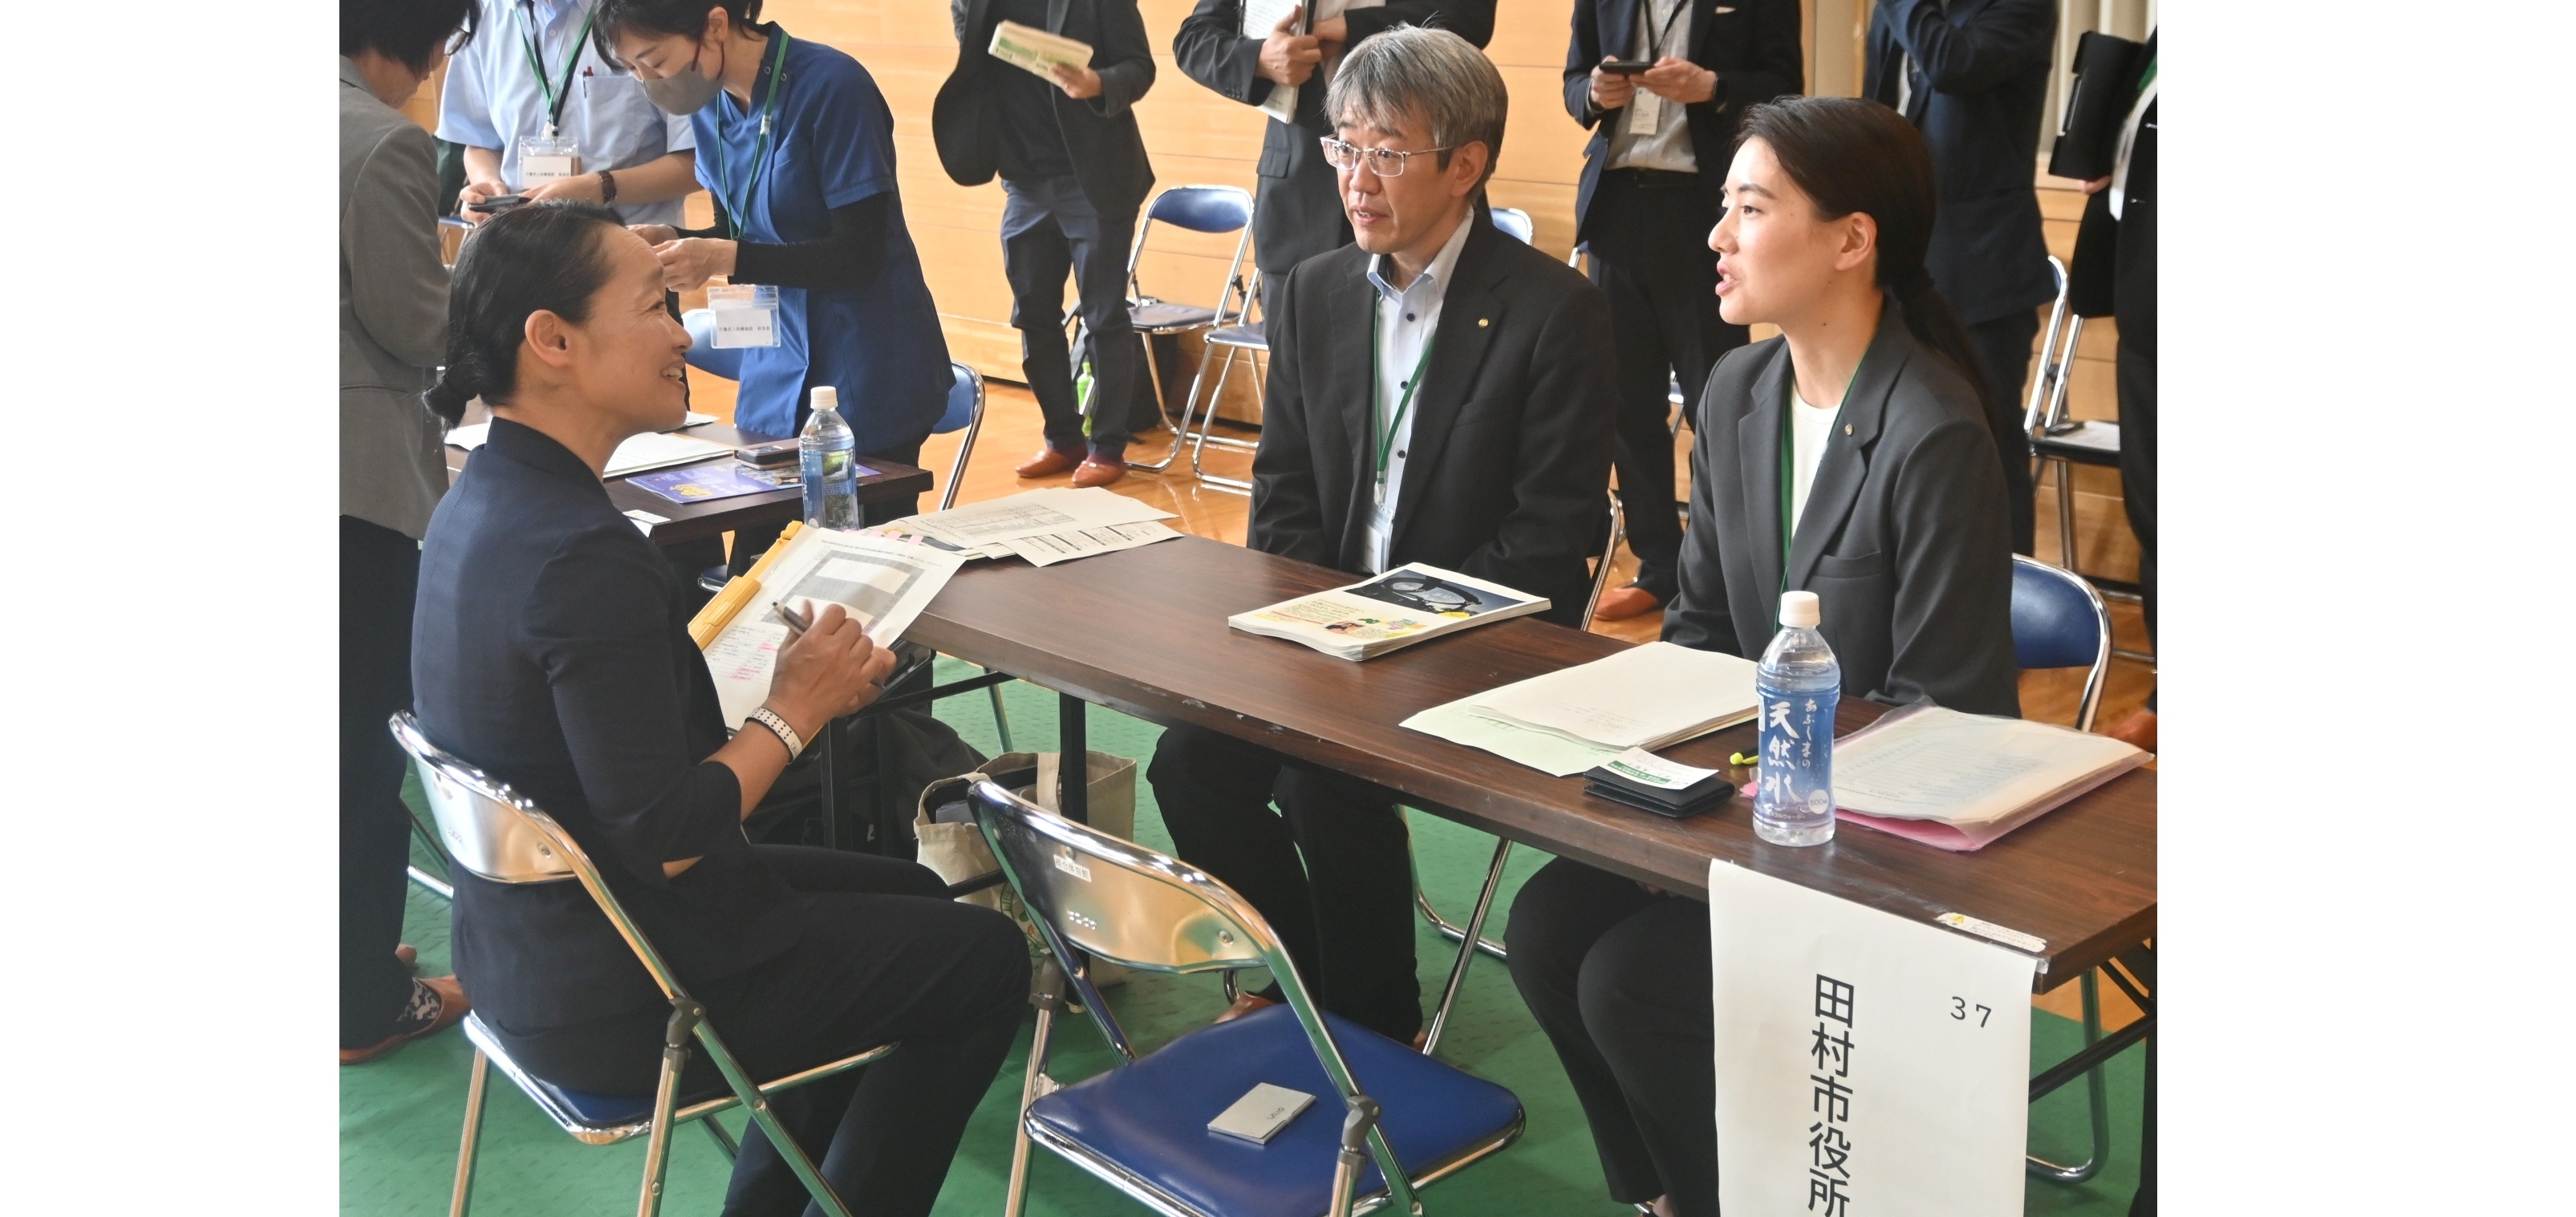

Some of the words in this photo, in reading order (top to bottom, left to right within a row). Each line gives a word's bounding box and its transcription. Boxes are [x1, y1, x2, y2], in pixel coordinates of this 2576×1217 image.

[1765, 700, 1803, 805] 天然水
[1950, 996, 1992, 1028] 37
[1807, 973, 1855, 1217] 田村市役所
